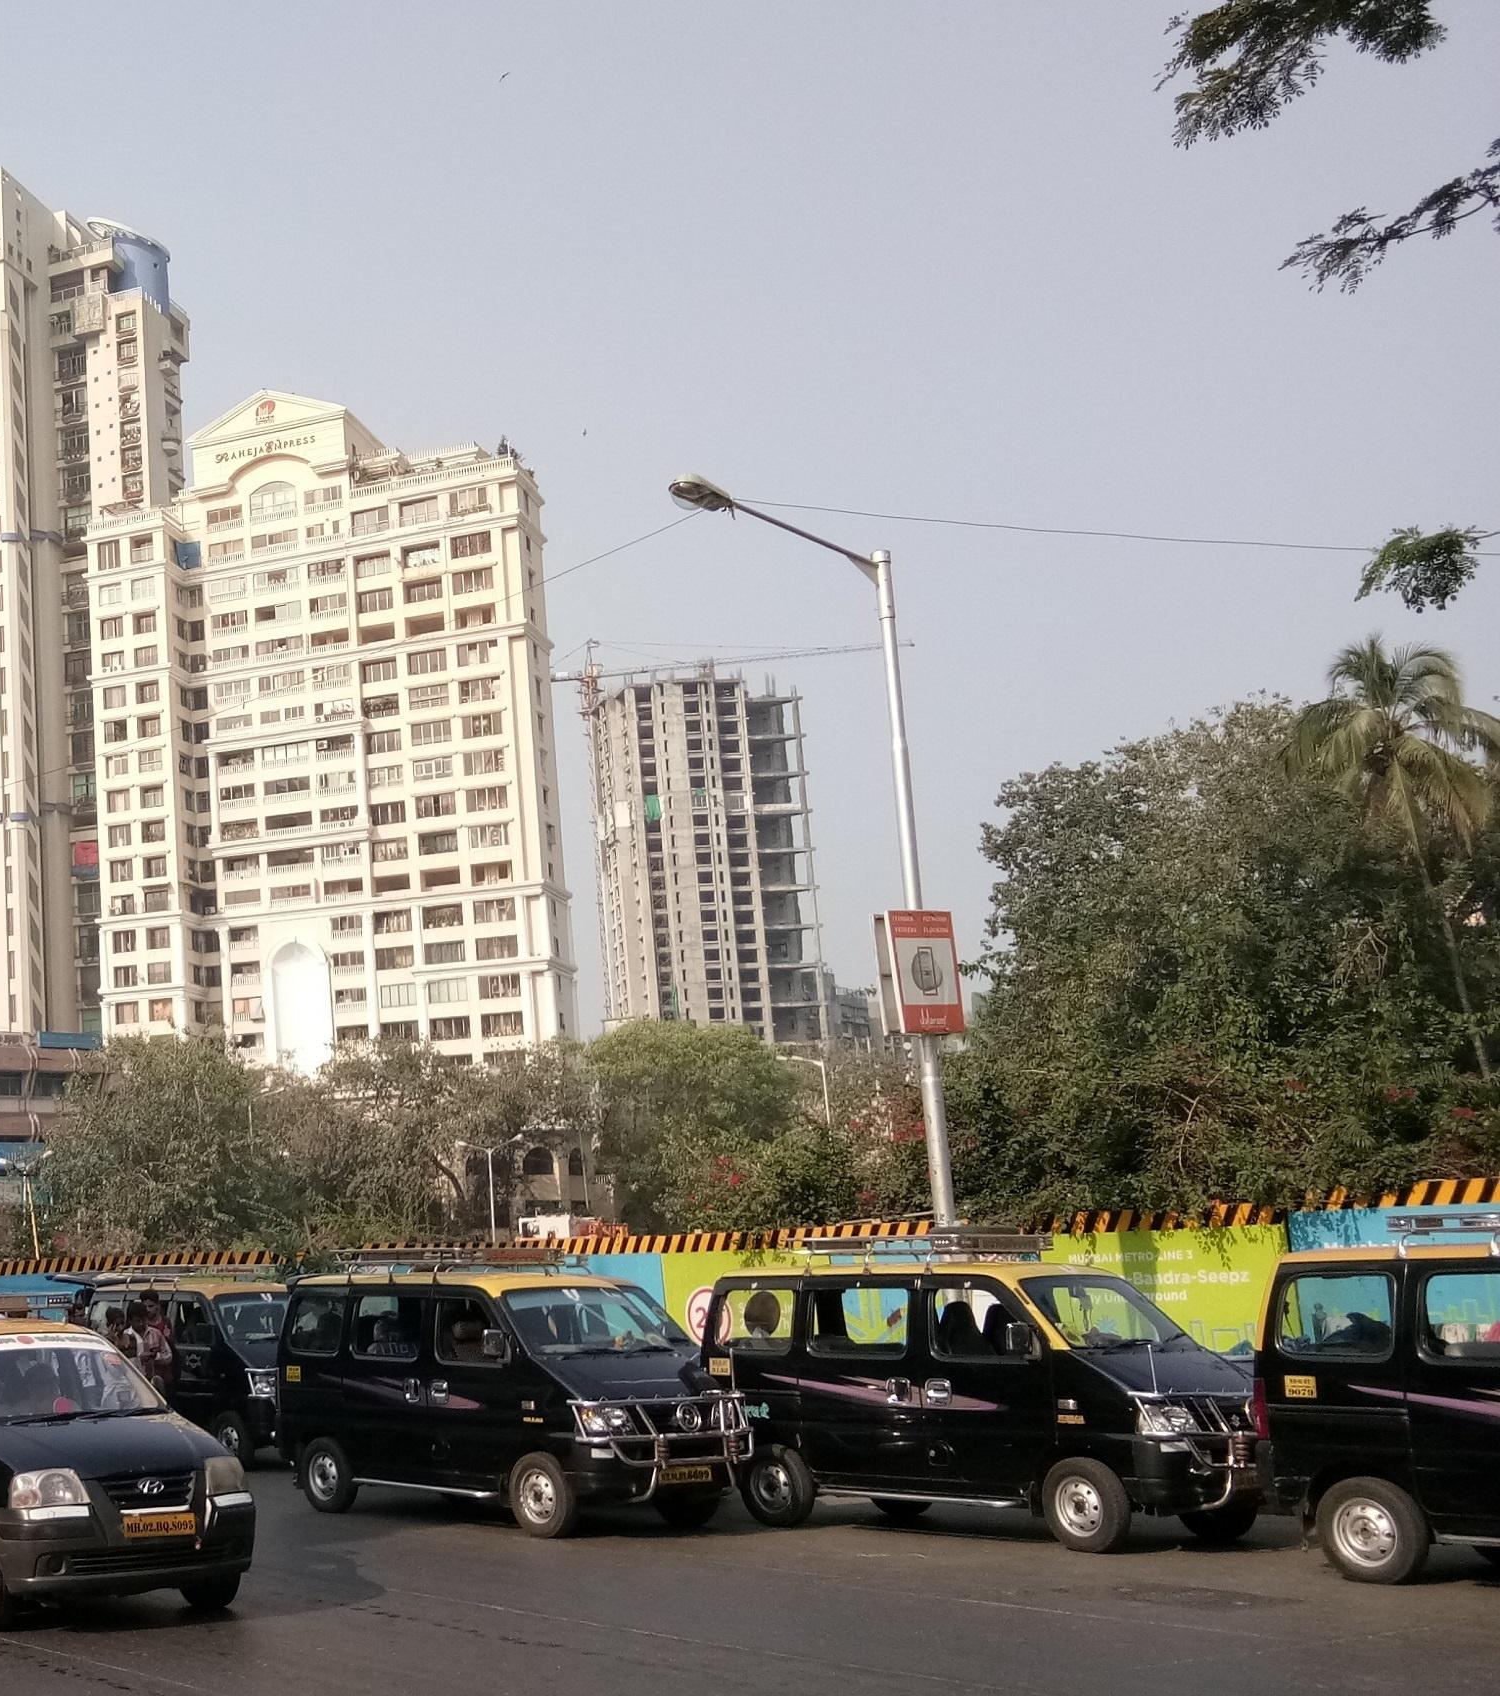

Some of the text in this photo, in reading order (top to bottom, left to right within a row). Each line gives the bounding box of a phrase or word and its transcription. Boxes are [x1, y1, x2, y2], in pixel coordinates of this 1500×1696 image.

[215, 436, 316, 464] RAHEJA EMPRESS
[1116, 1252, 1154, 1262] METRO
[1157, 1250, 1184, 1261] LINE
[1187, 1249, 1194, 1260] 3
[1288, 1388, 1314, 1396] 9079
